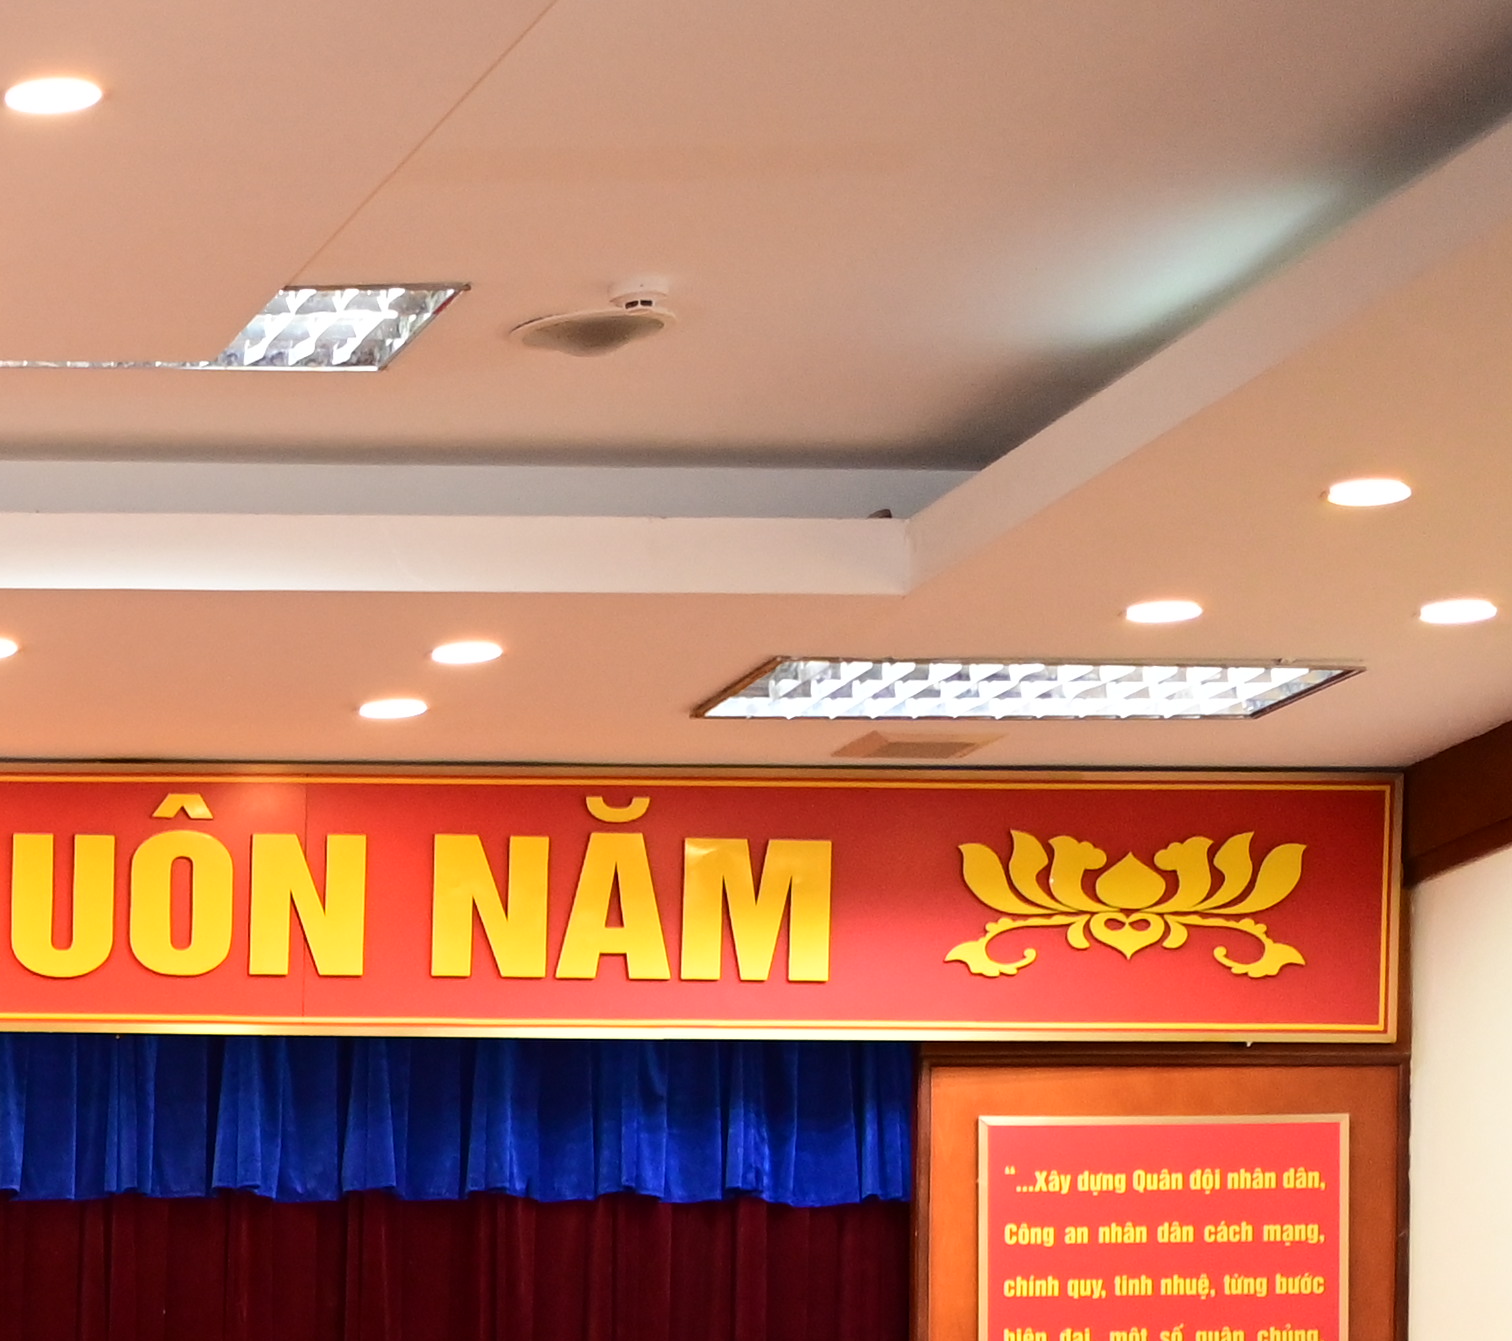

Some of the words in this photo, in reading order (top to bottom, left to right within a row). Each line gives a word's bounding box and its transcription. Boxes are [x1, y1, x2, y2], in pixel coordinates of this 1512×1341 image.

[429, 791, 836, 983] NĂM
[1077, 1170, 1127, 1196] dựng
[1132, 1168, 1184, 1193] Quân
[1189, 1168, 1221, 1195] đội
[1227, 1167, 1277, 1190] nhân
[1282, 1166, 1326, 1191] dân,
[1004, 1223, 1055, 1248] Công
[1064, 1226, 1089, 1245] an
[1098, 1221, 1148, 1244] nhân
[1156, 1221, 1195, 1243] dân
[1203, 1220, 1253, 1243] cách
[1262, 1223, 1325, 1247] mạng,
[1003, 1275, 1060, 1298] chính
[1067, 1278, 1107, 1300] quy,
[1113, 1274, 1153, 1297] tinh
[1160, 1273, 1216, 1300] nhuệ,
[1275, 1272, 1325, 1295] bước
